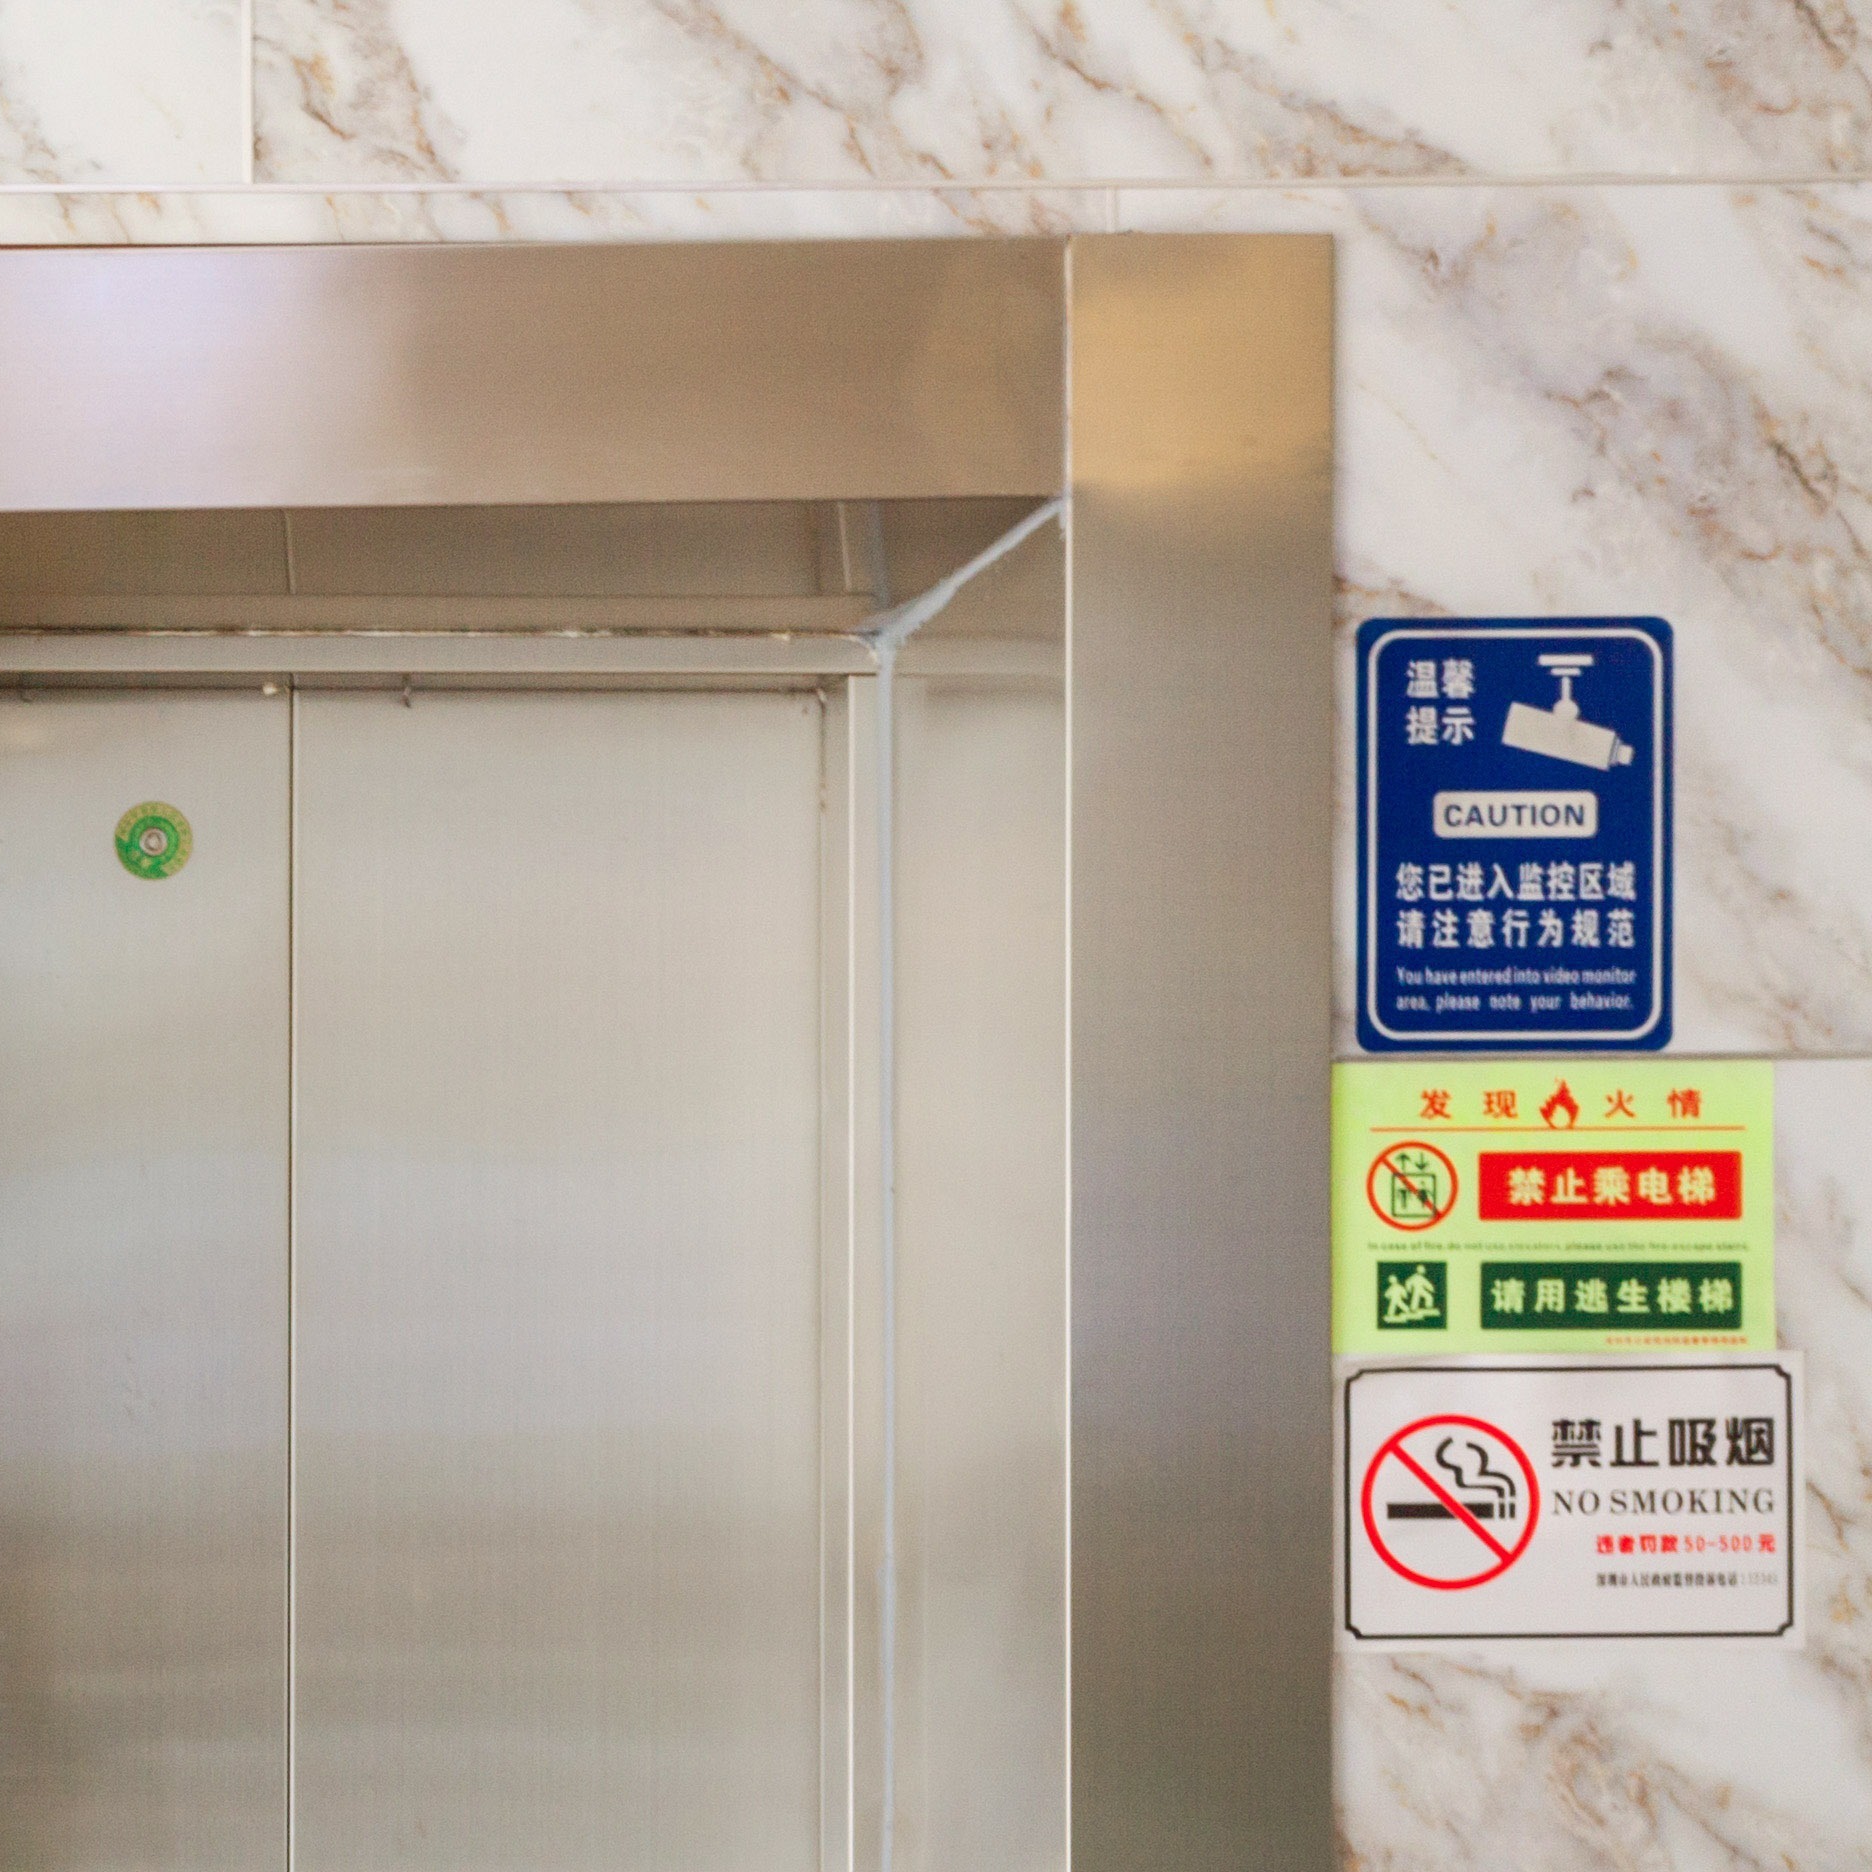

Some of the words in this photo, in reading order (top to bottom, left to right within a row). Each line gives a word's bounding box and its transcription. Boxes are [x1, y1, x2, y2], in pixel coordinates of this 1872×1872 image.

[1406, 660, 1474, 699] 温馨
[1406, 707, 1475, 746] 提示
[1444, 804, 1585, 828] CAUTION
[1395, 862, 1637, 901] 您已进入监控区域
[1396, 909, 1636, 949] 请注意行为规范
[1508, 1167, 1716, 1206] 禁止乘电梯
[1491, 1277, 1735, 1315] 请用逃生楼梯
[1551, 1417, 1775, 1468] 禁止吸烟
[1553, 1490, 1600, 1515] NO
[1610, 1488, 1774, 1514] SMOKING
